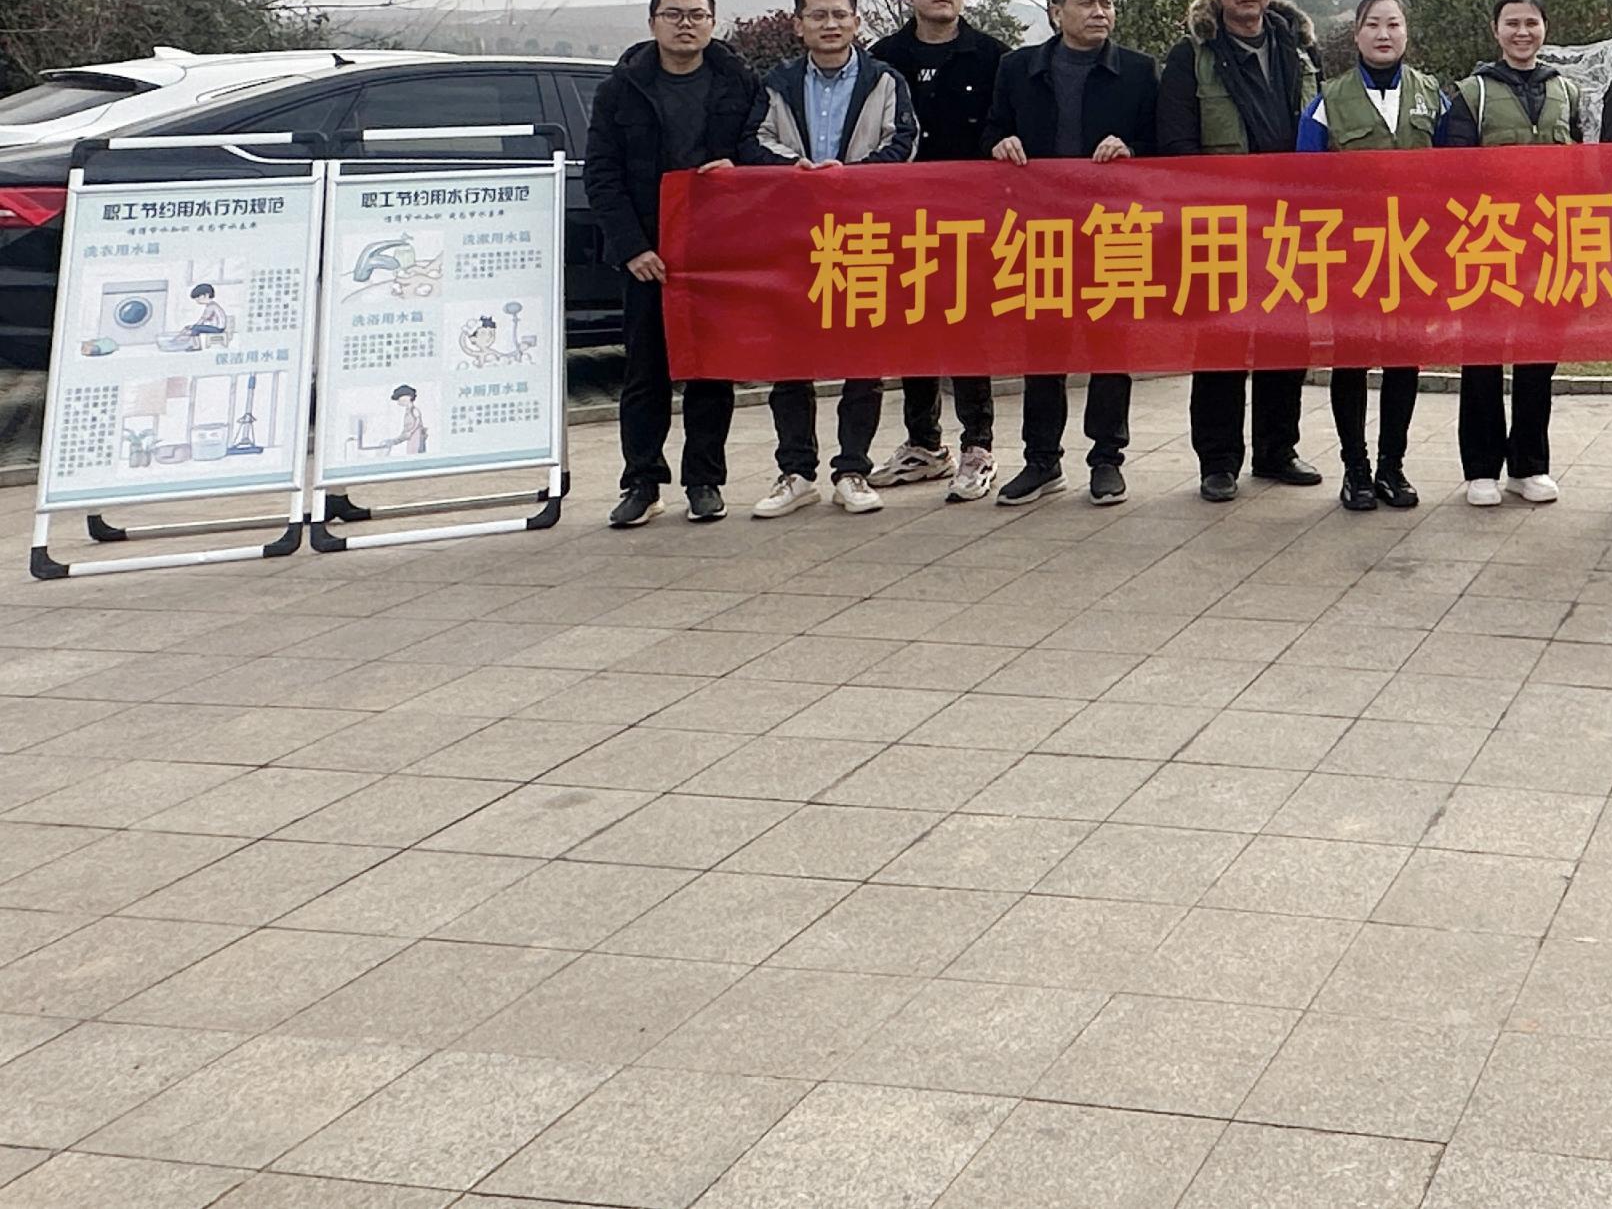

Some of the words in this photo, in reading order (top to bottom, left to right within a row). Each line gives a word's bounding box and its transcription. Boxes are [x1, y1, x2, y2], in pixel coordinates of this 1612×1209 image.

[102, 196, 285, 221] 职工节约用水行为规范
[361, 185, 530, 209] 职工节约用水行为规范
